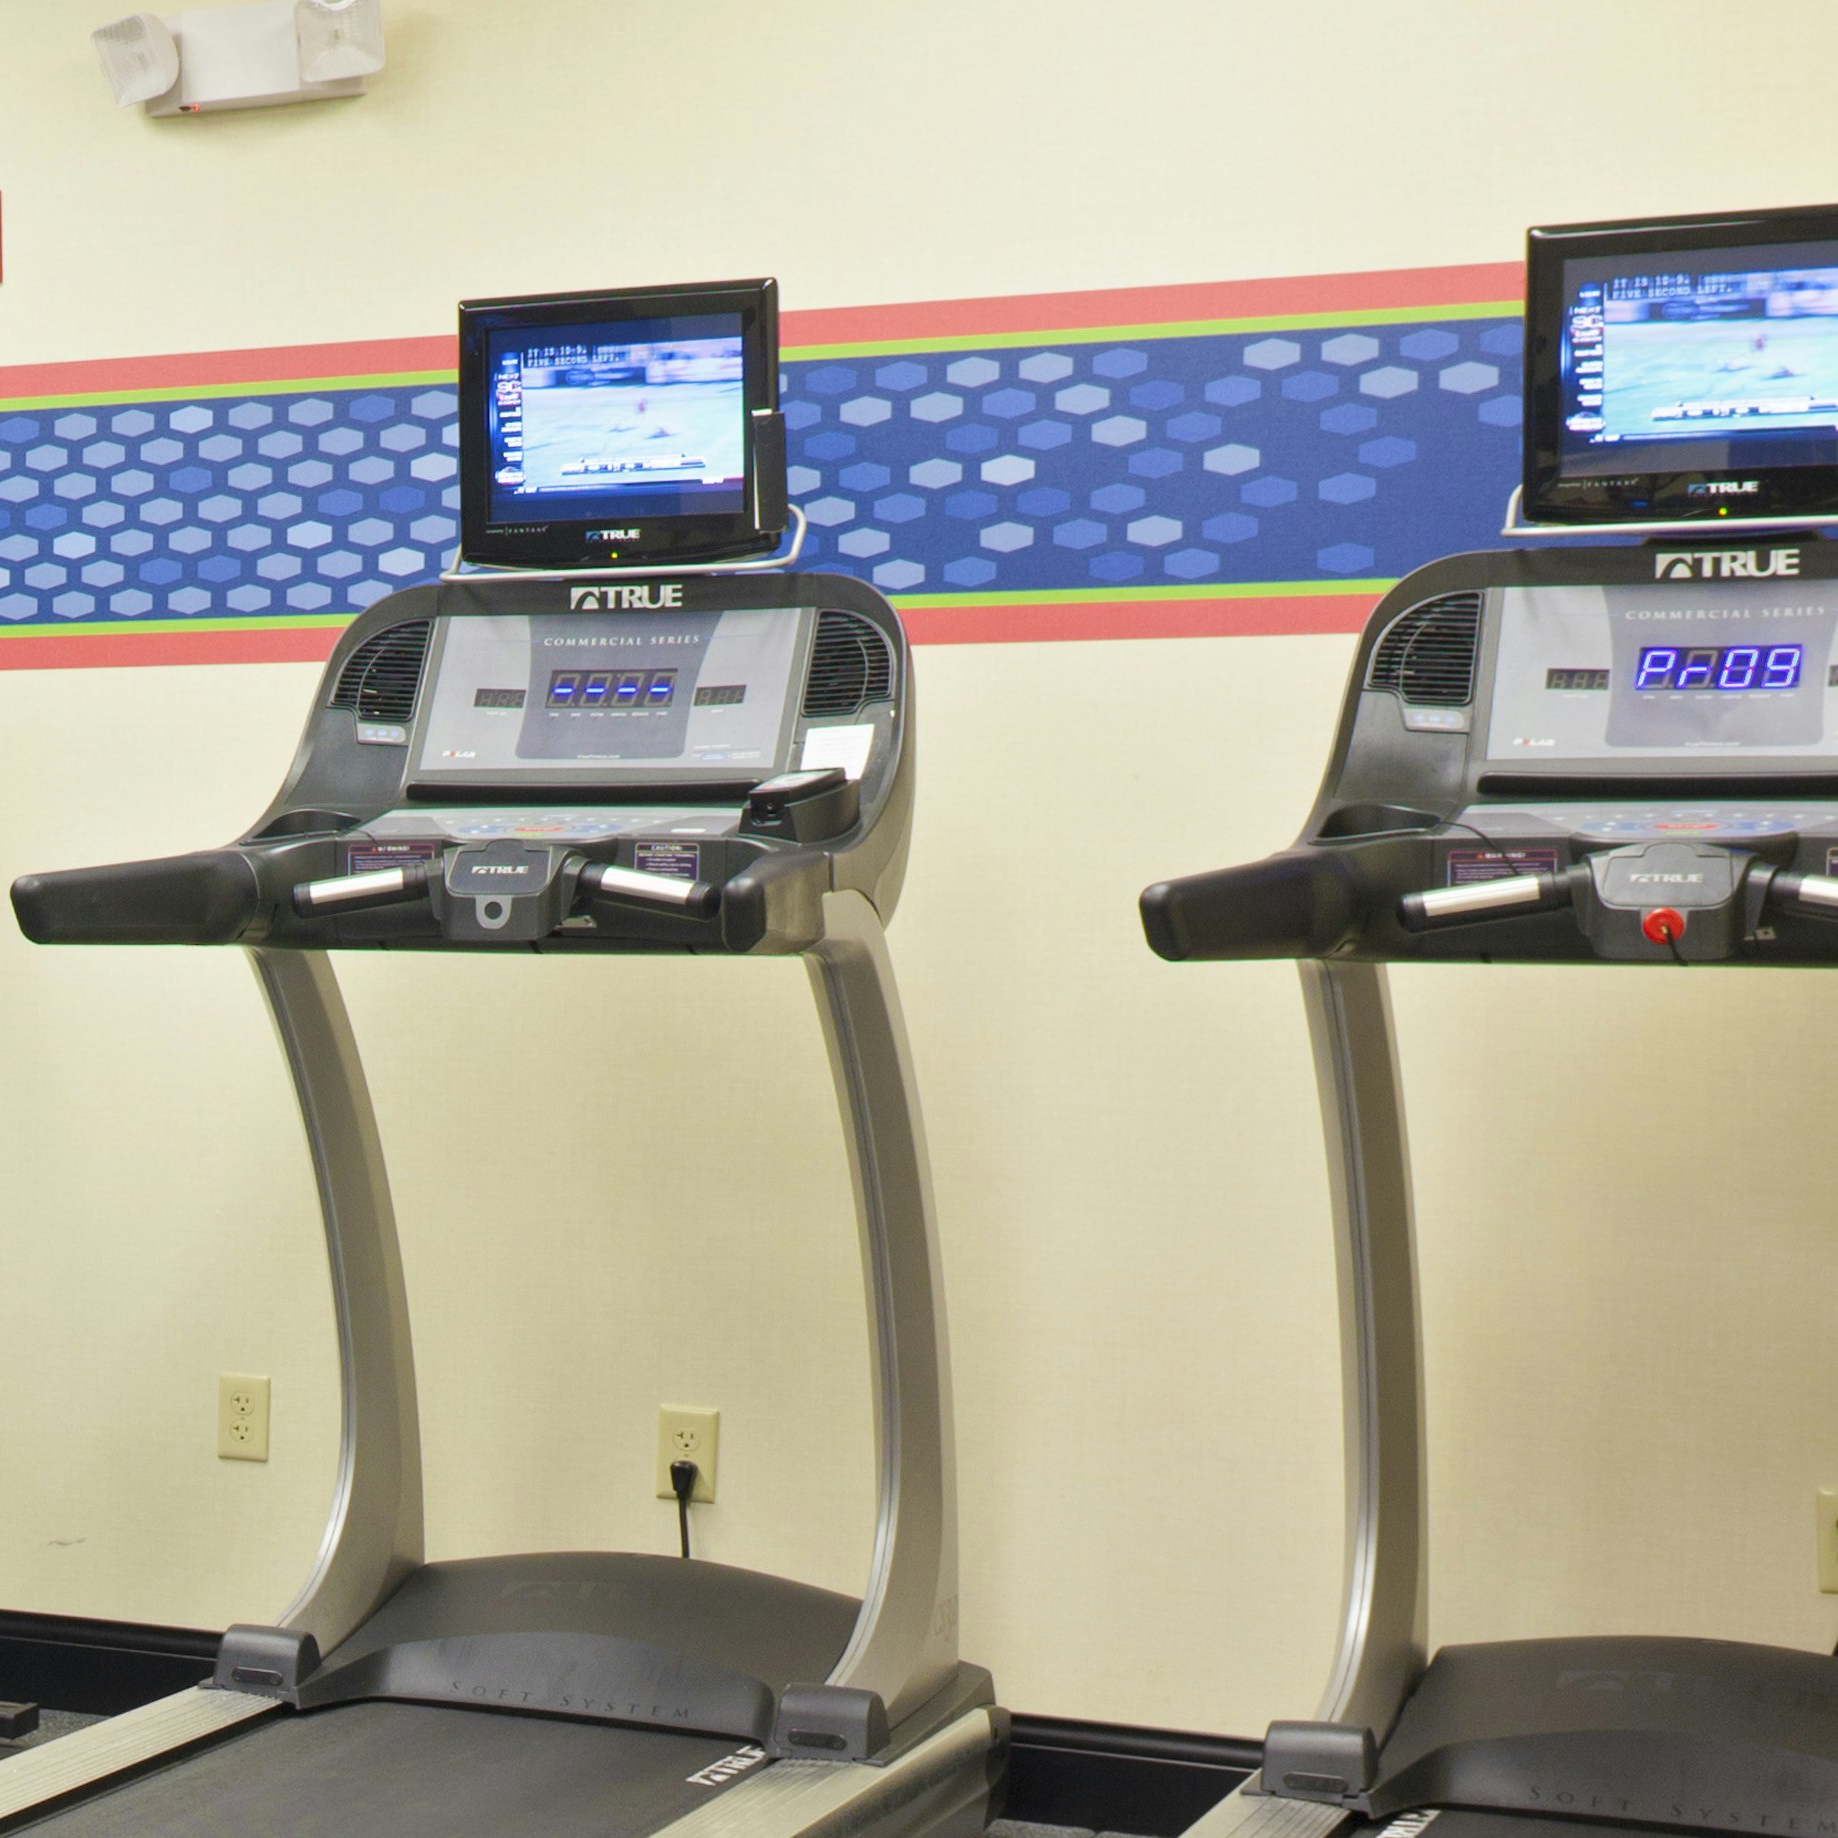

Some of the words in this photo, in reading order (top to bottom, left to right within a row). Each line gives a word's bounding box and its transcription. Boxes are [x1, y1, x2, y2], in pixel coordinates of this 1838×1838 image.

[1707, 480, 1760, 493] TRUE
[600, 528, 641, 541] TRUE
[1693, 549, 1800, 578] TRUE
[600, 584, 683, 609] TRUE
[1625, 608, 1752, 621] COMMERCIAL
[1762, 605, 1826, 618] SERIES
[543, 635, 643, 647] COMMERCIAL
[650, 633, 700, 645] SERIES
[487, 864, 529, 876] TRUE
[1652, 873, 1704, 884] TRUE
[448, 1680, 533, 1702] SOFT
[559, 1694, 690, 1719] SYSTEM
[1529, 1786, 1631, 1811] SOFT
[1670, 1804, 1838, 1833] SYSTEM
